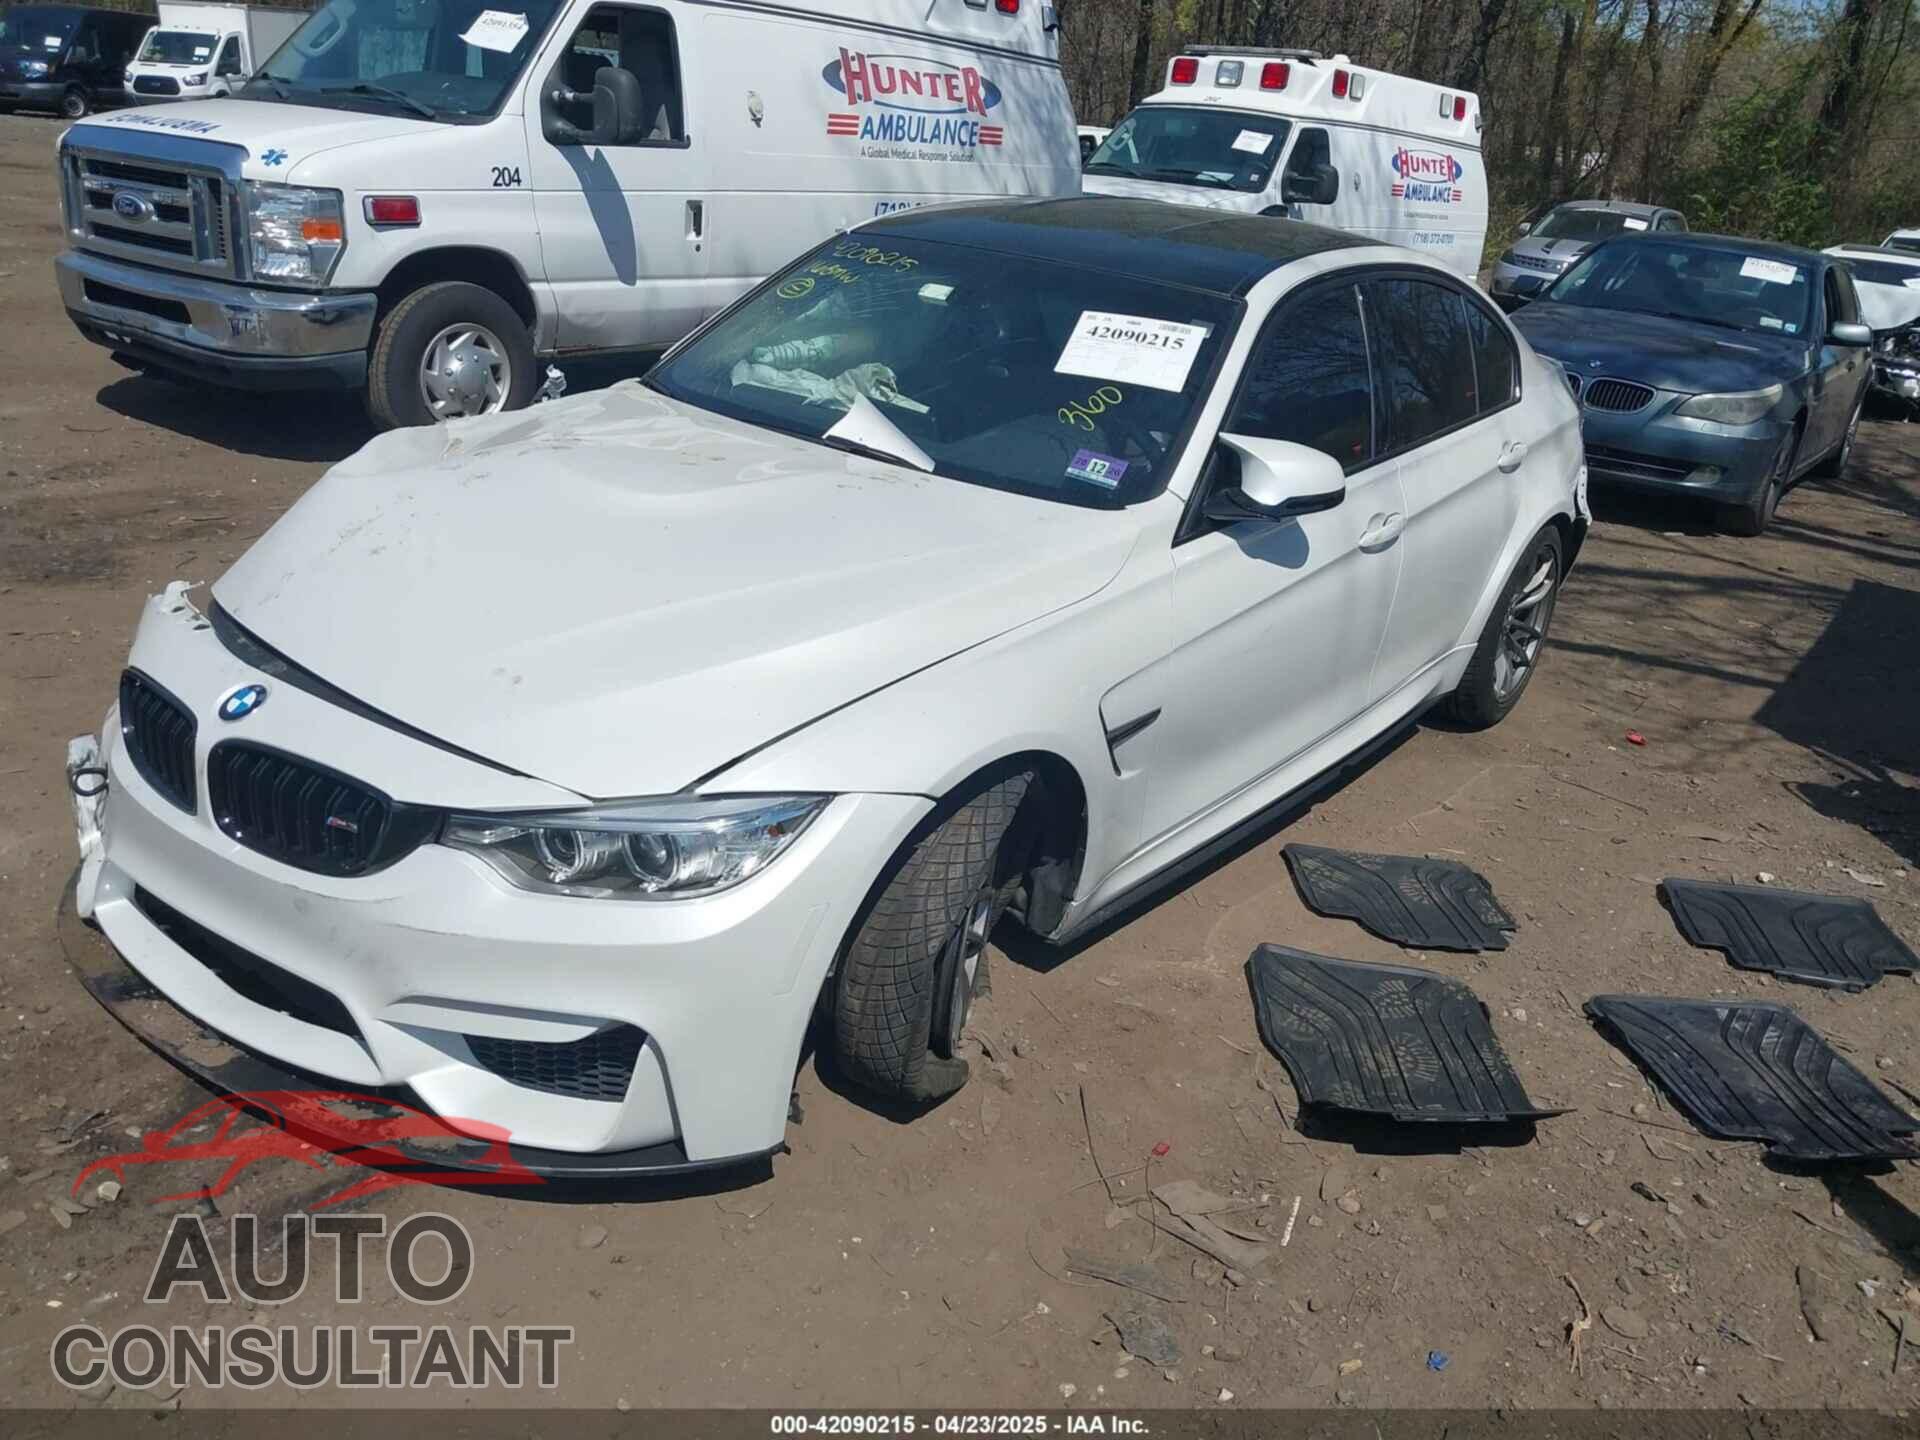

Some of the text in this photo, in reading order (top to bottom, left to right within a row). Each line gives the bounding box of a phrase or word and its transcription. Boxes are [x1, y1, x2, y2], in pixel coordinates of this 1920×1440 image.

[839, 47, 987, 117] HUNTER
[860, 113, 979, 147] AMBULANCE
[867, 146, 890, 158] Global
[890, 148, 917, 160] Medical
[918, 149, 948, 163] Response
[1398, 146, 1456, 184] HUNTER
[491, 166, 522, 187] 204
[1404, 183, 1451, 203] AMBULANCE
[1086, 325, 1185, 350] 42090215
[1057, 385, 1123, 432] 360
[1090, 461, 1106, 474] 12
